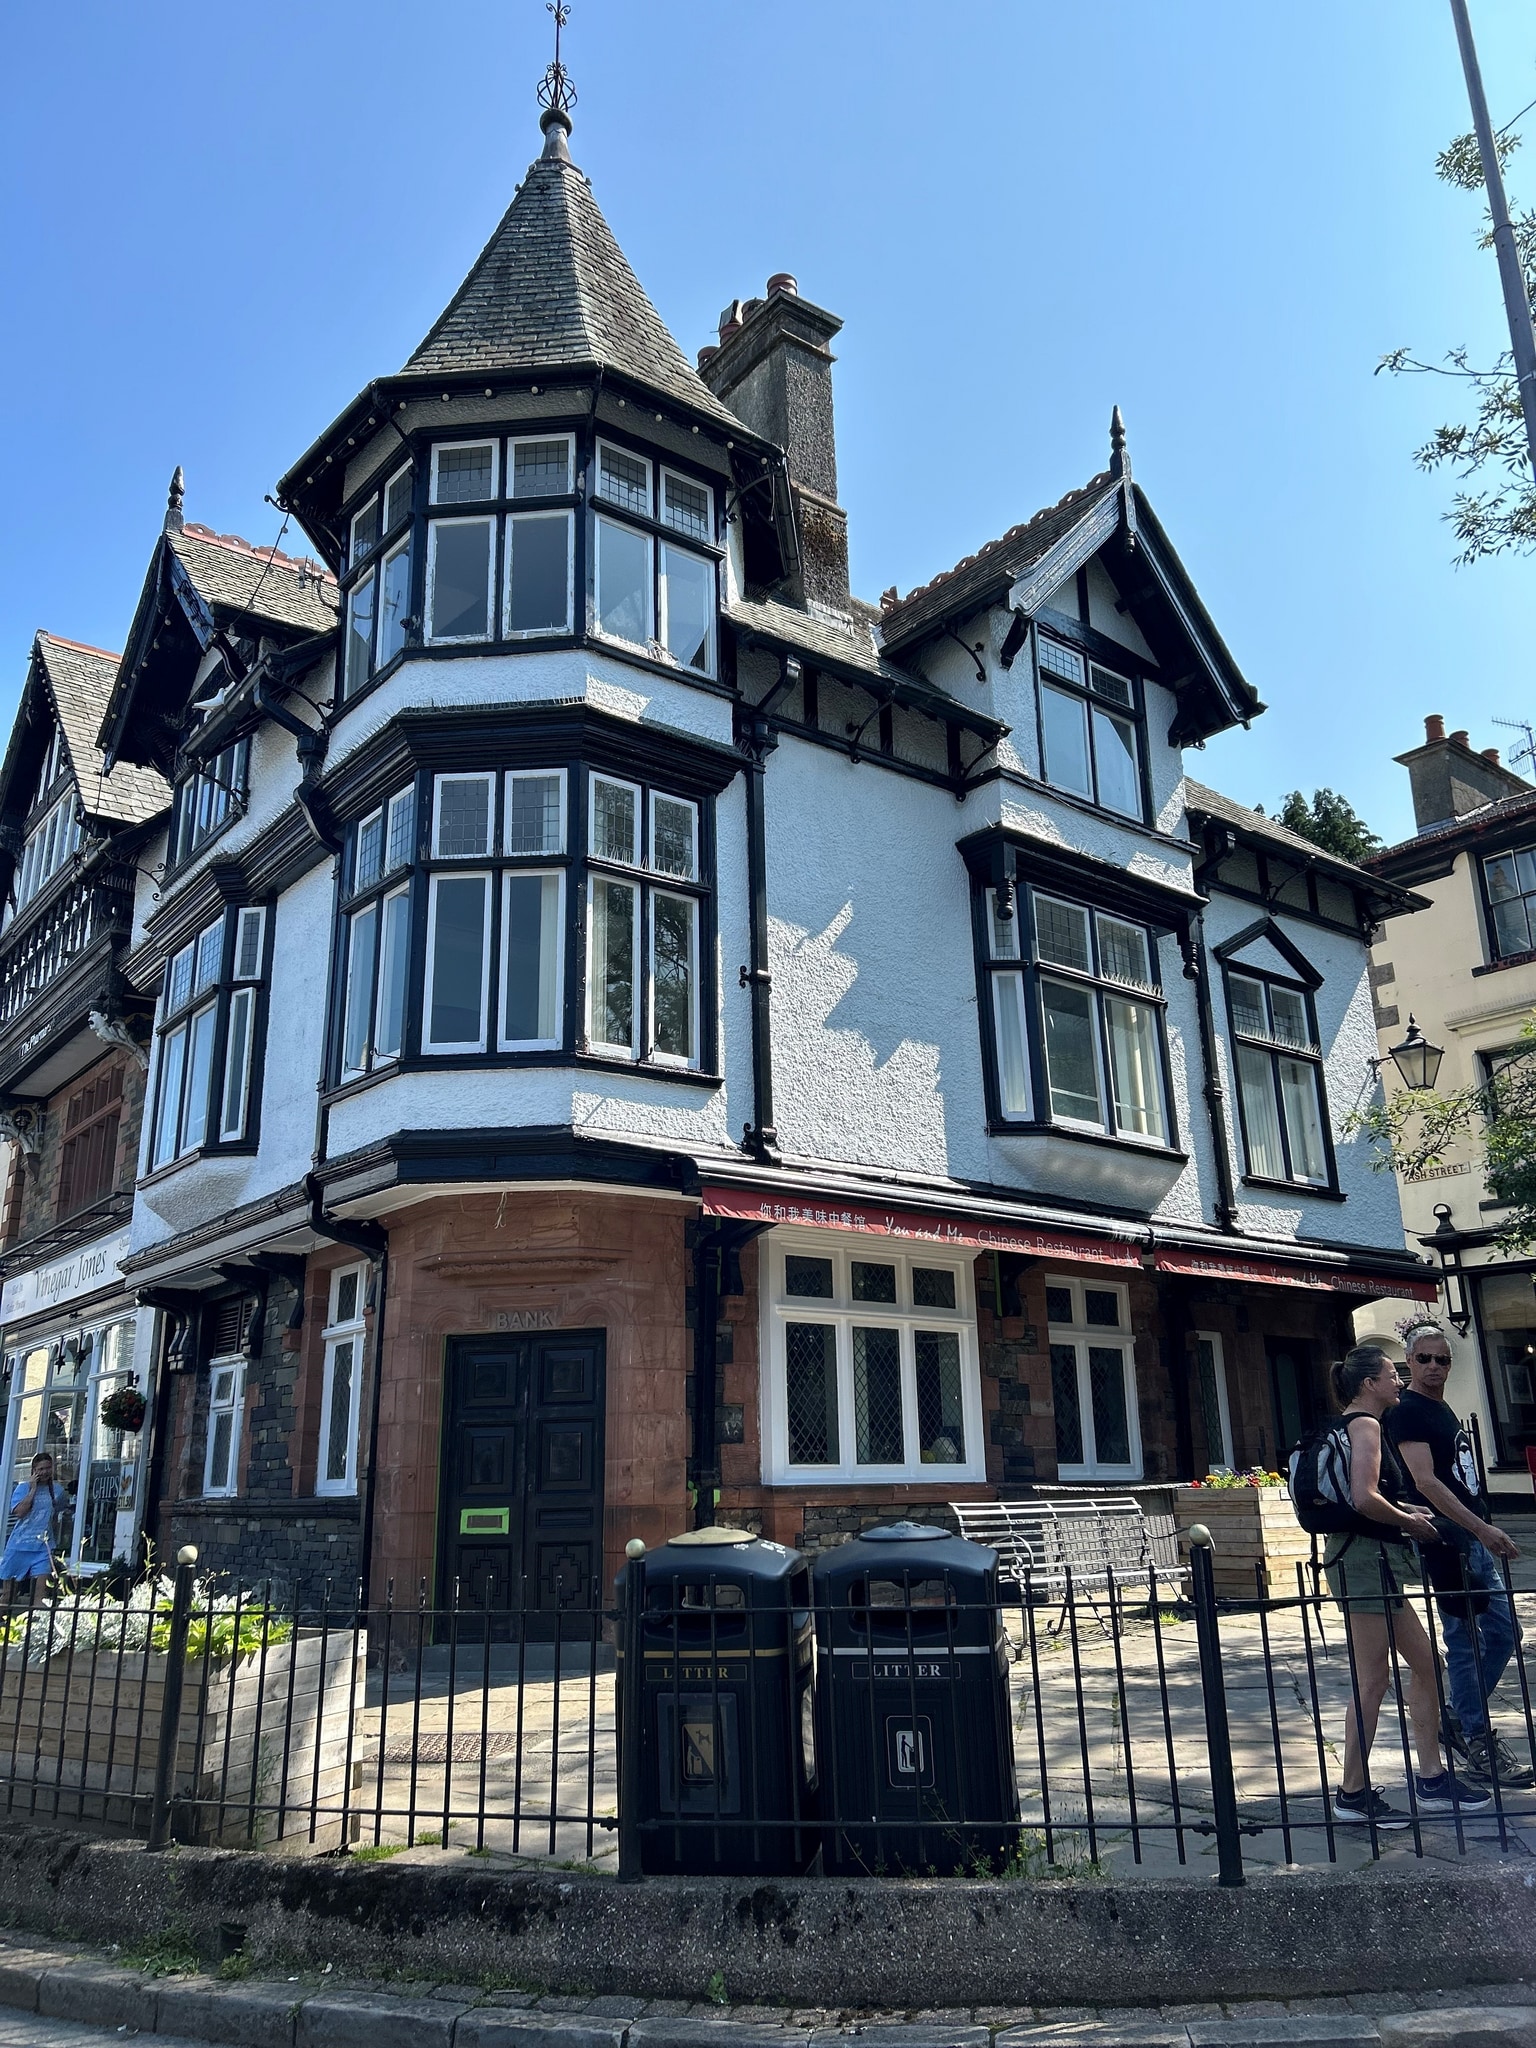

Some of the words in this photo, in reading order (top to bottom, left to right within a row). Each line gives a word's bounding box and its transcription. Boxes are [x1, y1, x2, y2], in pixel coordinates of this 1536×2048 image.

[1408, 1170, 1427, 1181] ASH
[1429, 1164, 1464, 1178] STREET
[760, 1202, 866, 1231] 你和我美味中餐馆
[885, 1216, 910, 1235] You
[915, 1223, 941, 1240] and
[946, 1223, 964, 1242] Me
[978, 1229, 1031, 1251] Chinese
[1036, 1237, 1104, 1262] Restaurant
[34, 1265, 75, 1303] Vinegar
[74, 1250, 107, 1289] Jones
[1331, 1275, 1366, 1293] Chinese
[1369, 1280, 1413, 1298] Restaurant
[496, 1311, 553, 1330] BANK
[93, 1475, 120, 1500] CHIPS
[663, 1667, 728, 1679] LTTER
